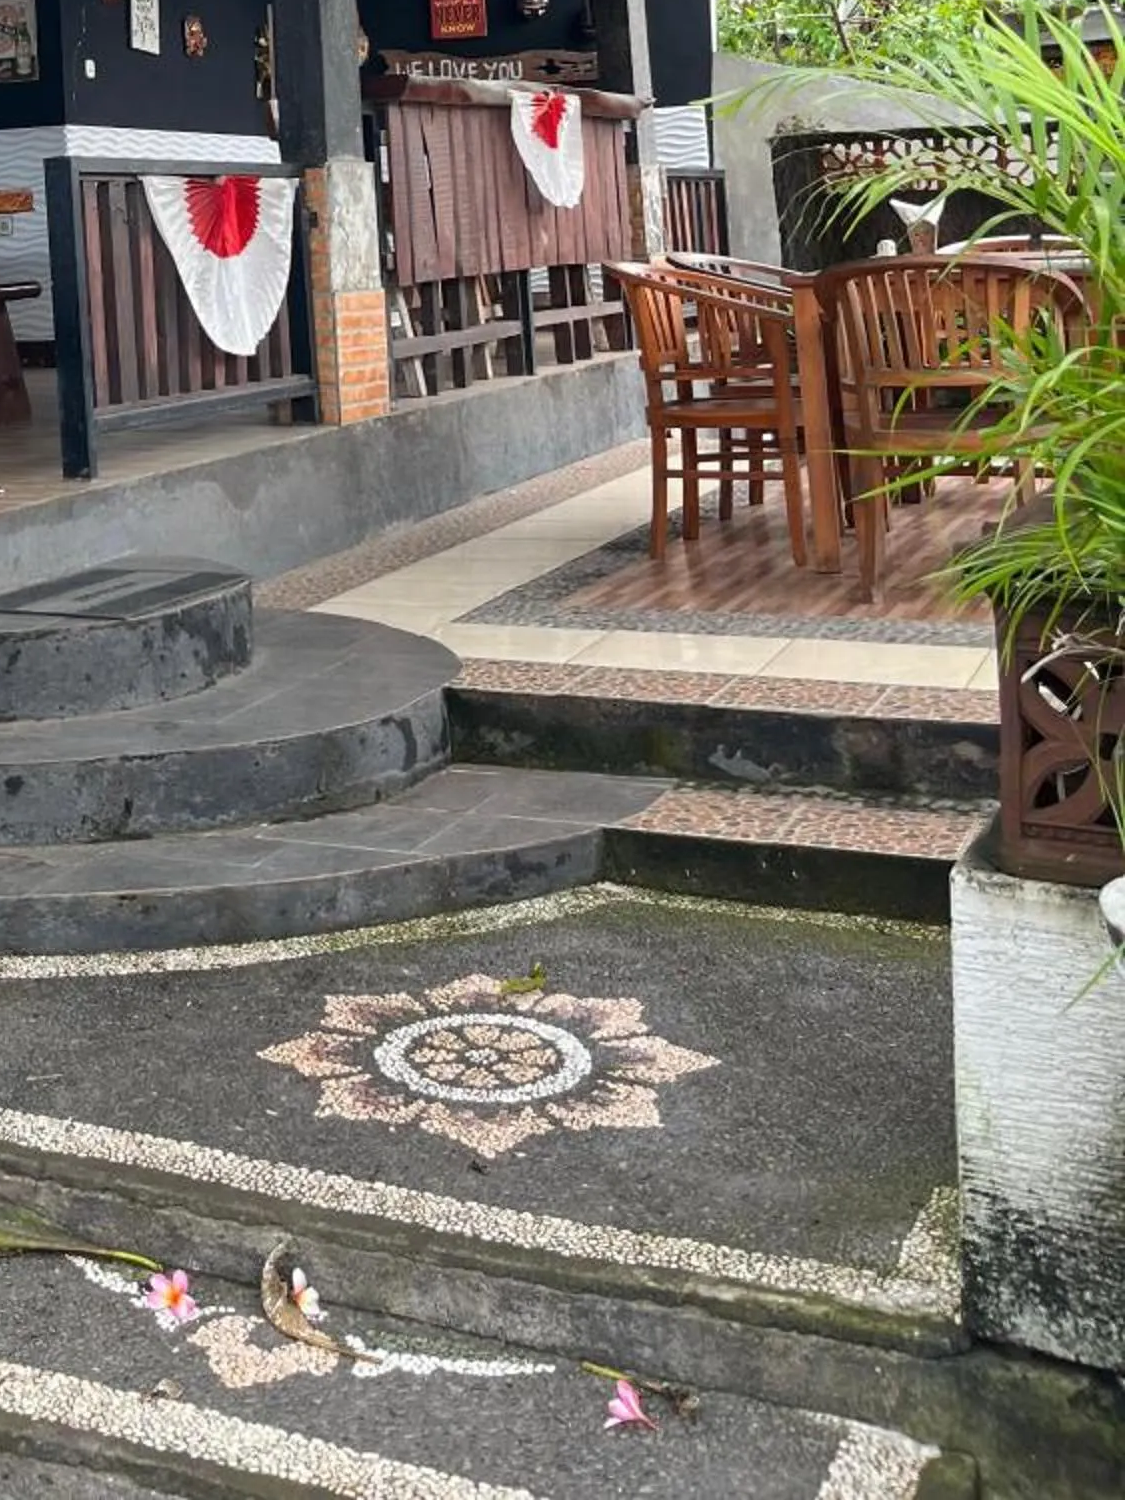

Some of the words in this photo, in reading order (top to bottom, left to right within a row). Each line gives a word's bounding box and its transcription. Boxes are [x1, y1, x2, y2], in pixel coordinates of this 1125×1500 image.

[440, 23, 476, 33] KNOW
[428, 59, 479, 79] LOVE
[483, 60, 524, 80] YOU
